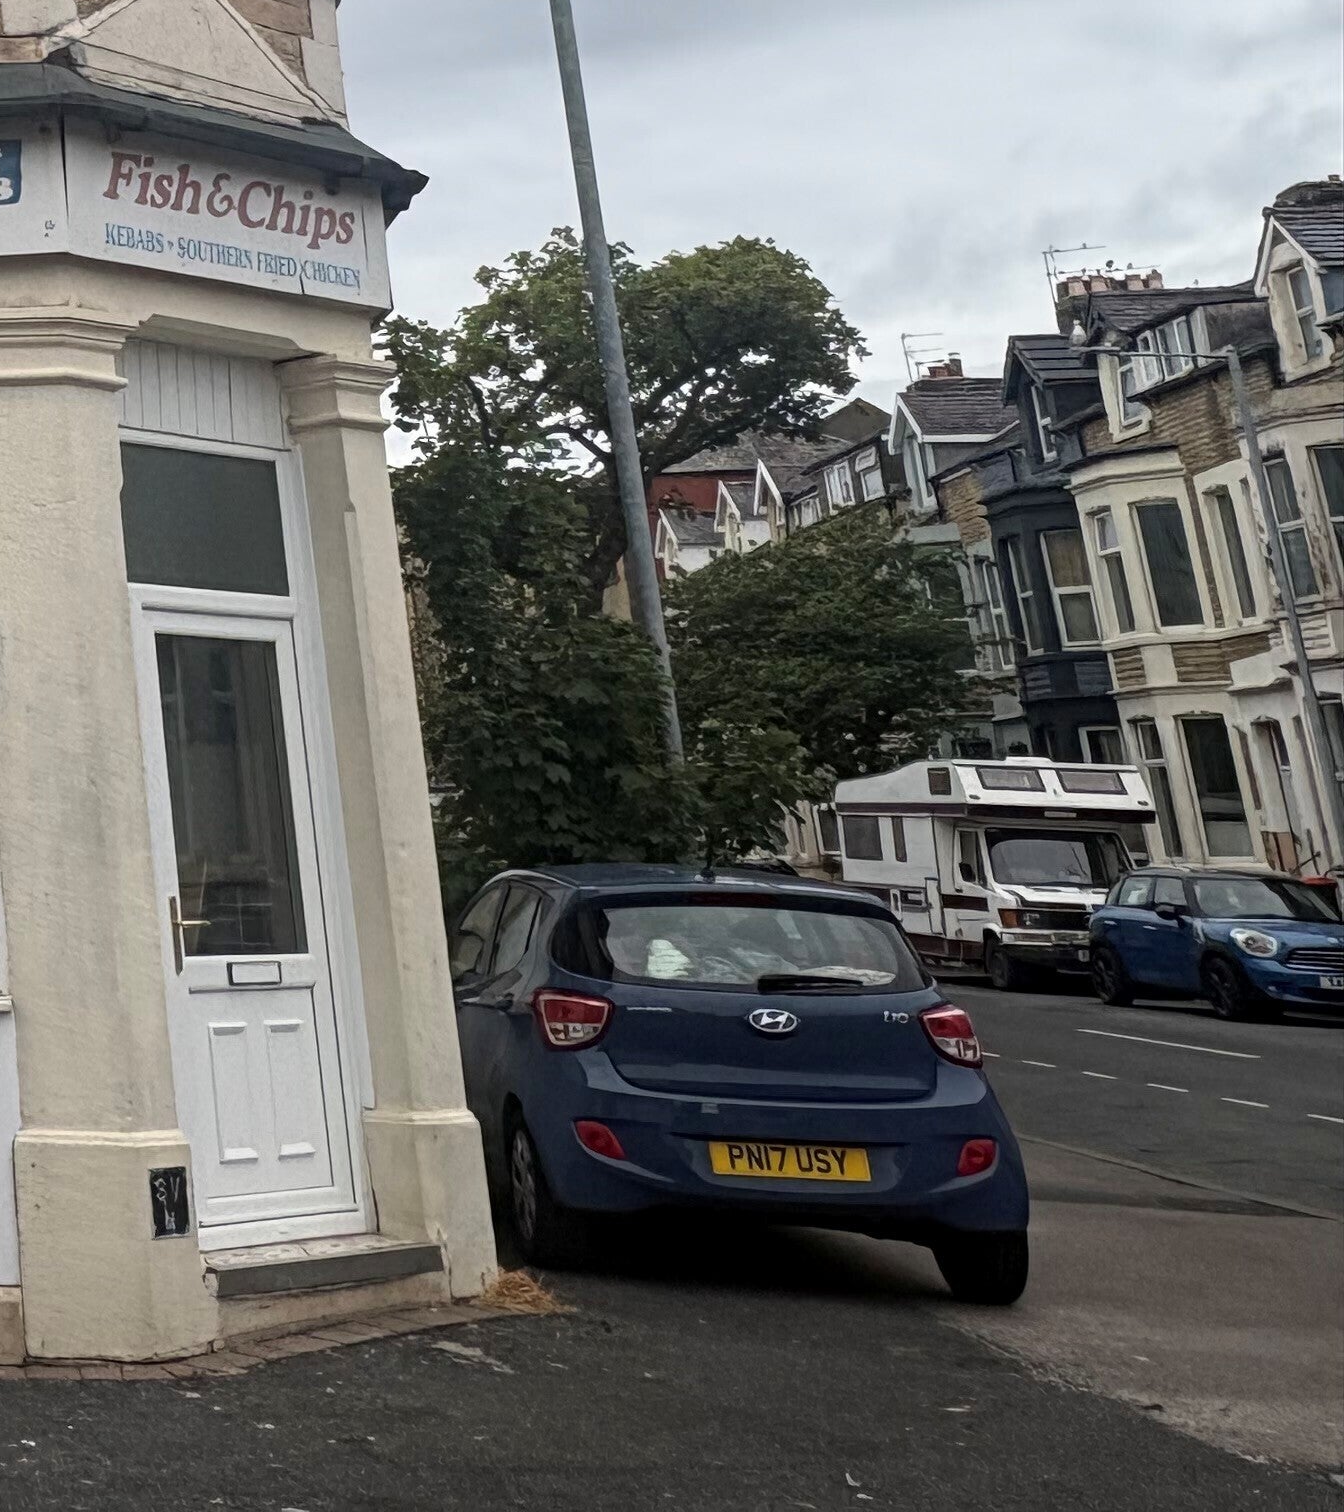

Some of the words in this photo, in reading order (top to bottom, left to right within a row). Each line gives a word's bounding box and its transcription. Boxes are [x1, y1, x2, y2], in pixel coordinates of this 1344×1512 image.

[105, 222, 164, 253] KEBABS
[177, 237, 253, 270] SOUTHERN
[257, 251, 297, 277] FRIED
[304, 259, 360, 291] CHICKEN
[726, 1144, 787, 1172] PN17
[795, 1147, 847, 1175] USY
